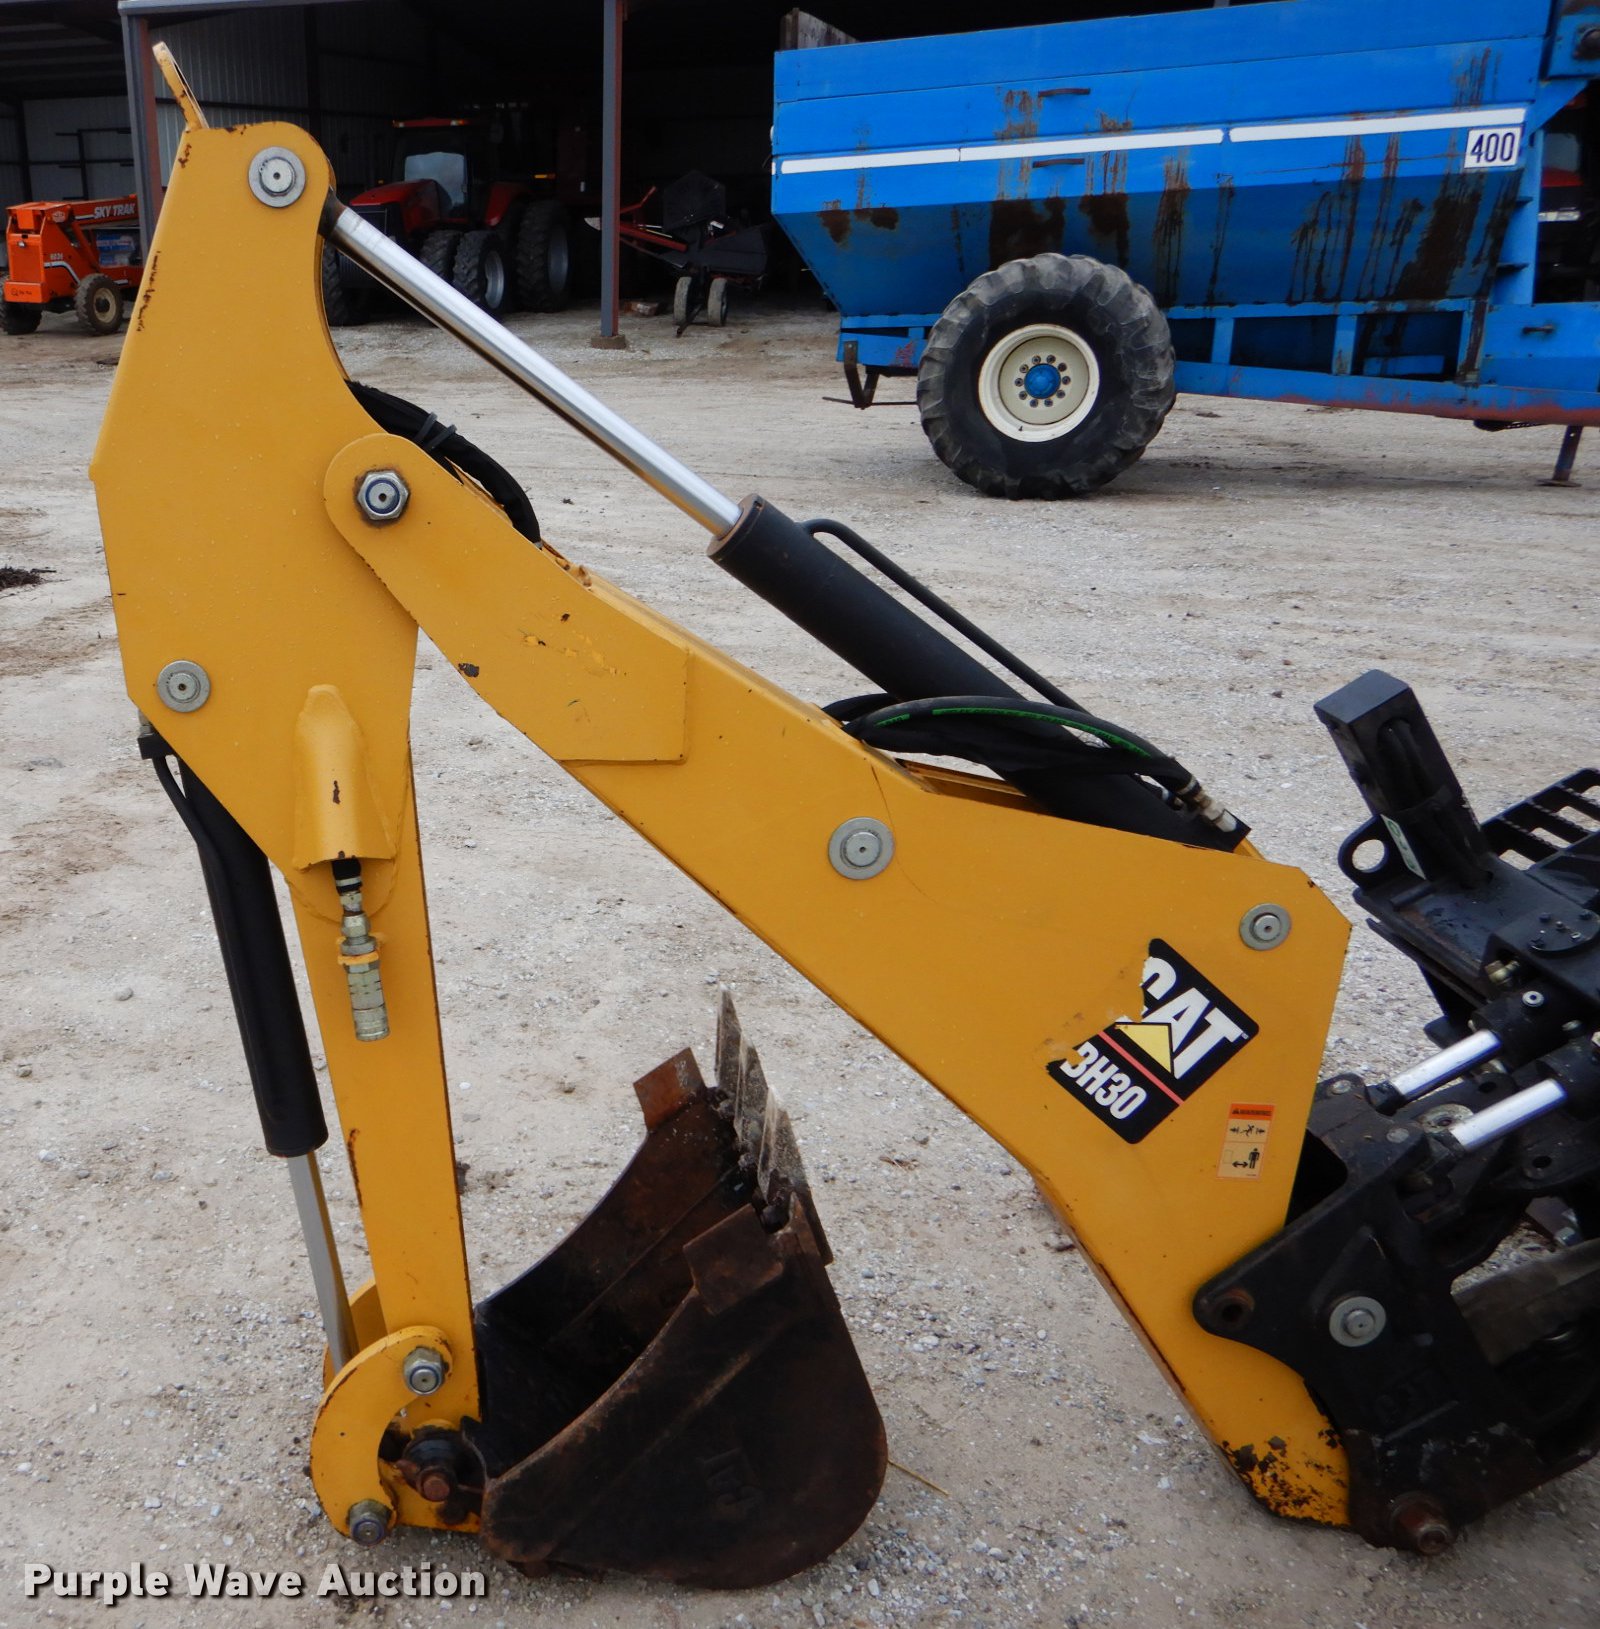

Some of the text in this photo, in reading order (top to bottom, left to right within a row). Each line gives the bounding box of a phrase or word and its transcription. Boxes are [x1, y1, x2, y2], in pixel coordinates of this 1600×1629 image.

[1470, 132, 1516, 163] 400
[94, 203, 136, 219] SKY TRAK
